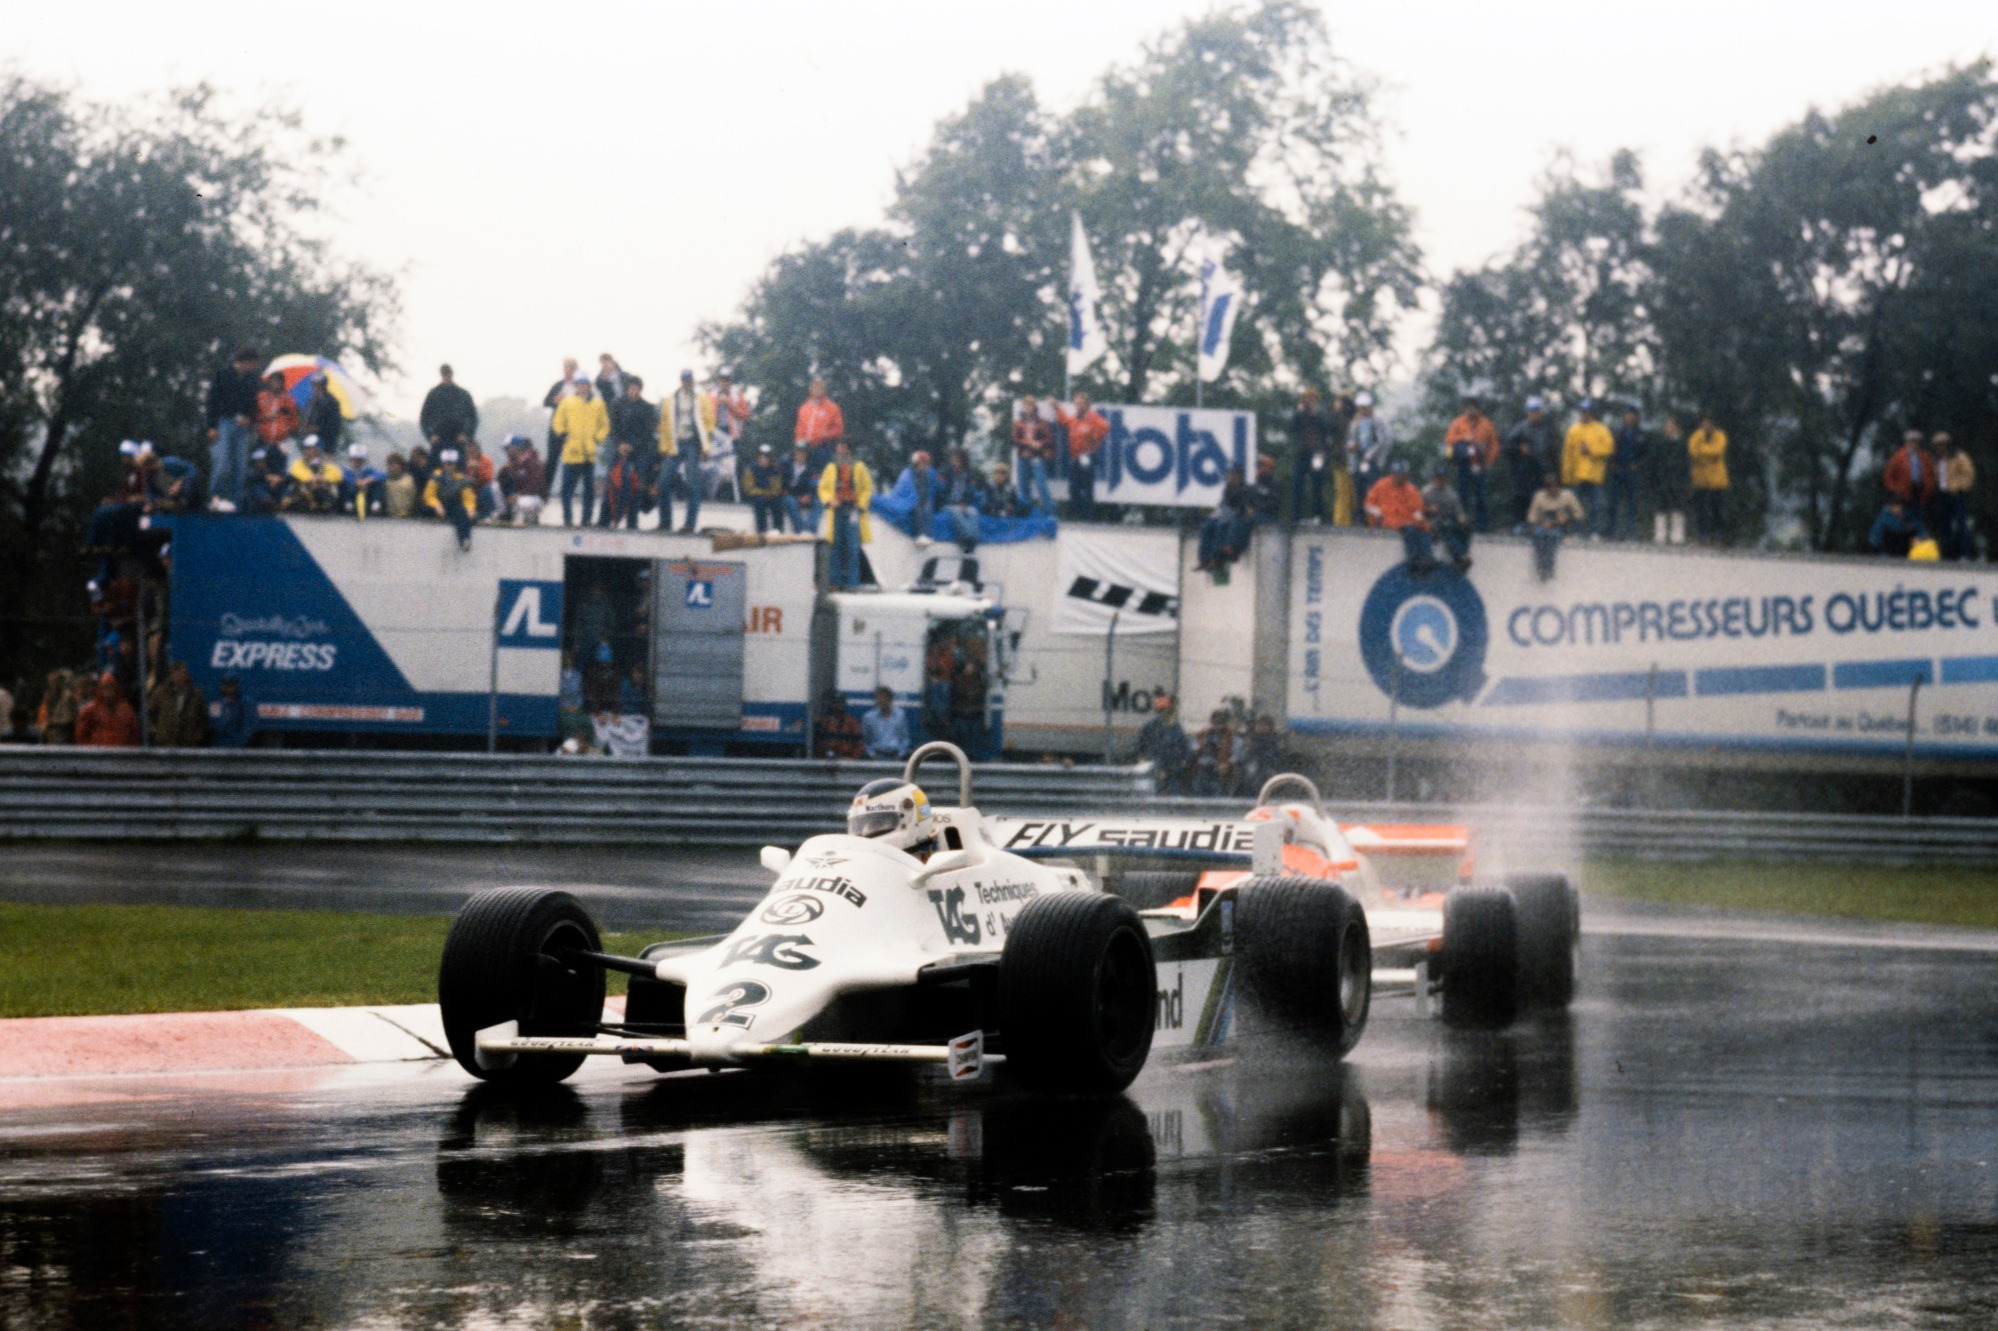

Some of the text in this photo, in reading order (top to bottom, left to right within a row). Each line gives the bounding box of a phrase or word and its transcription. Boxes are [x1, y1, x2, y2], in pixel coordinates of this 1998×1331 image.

[1507, 596, 1814, 647] COMPRESSEURS
[1826, 584, 1978, 634] QUÉBEC
[211, 640, 337, 670] EXPRESS
[865, 803, 896, 812] Marlboro
[1004, 822, 1255, 852] FLY saudia
[775, 876, 867, 908] audia
[974, 880, 1039, 905] Techniques
[927, 883, 981, 945] TAG
[696, 978, 772, 1030] 2
[1153, 971, 1183, 1029] nd
